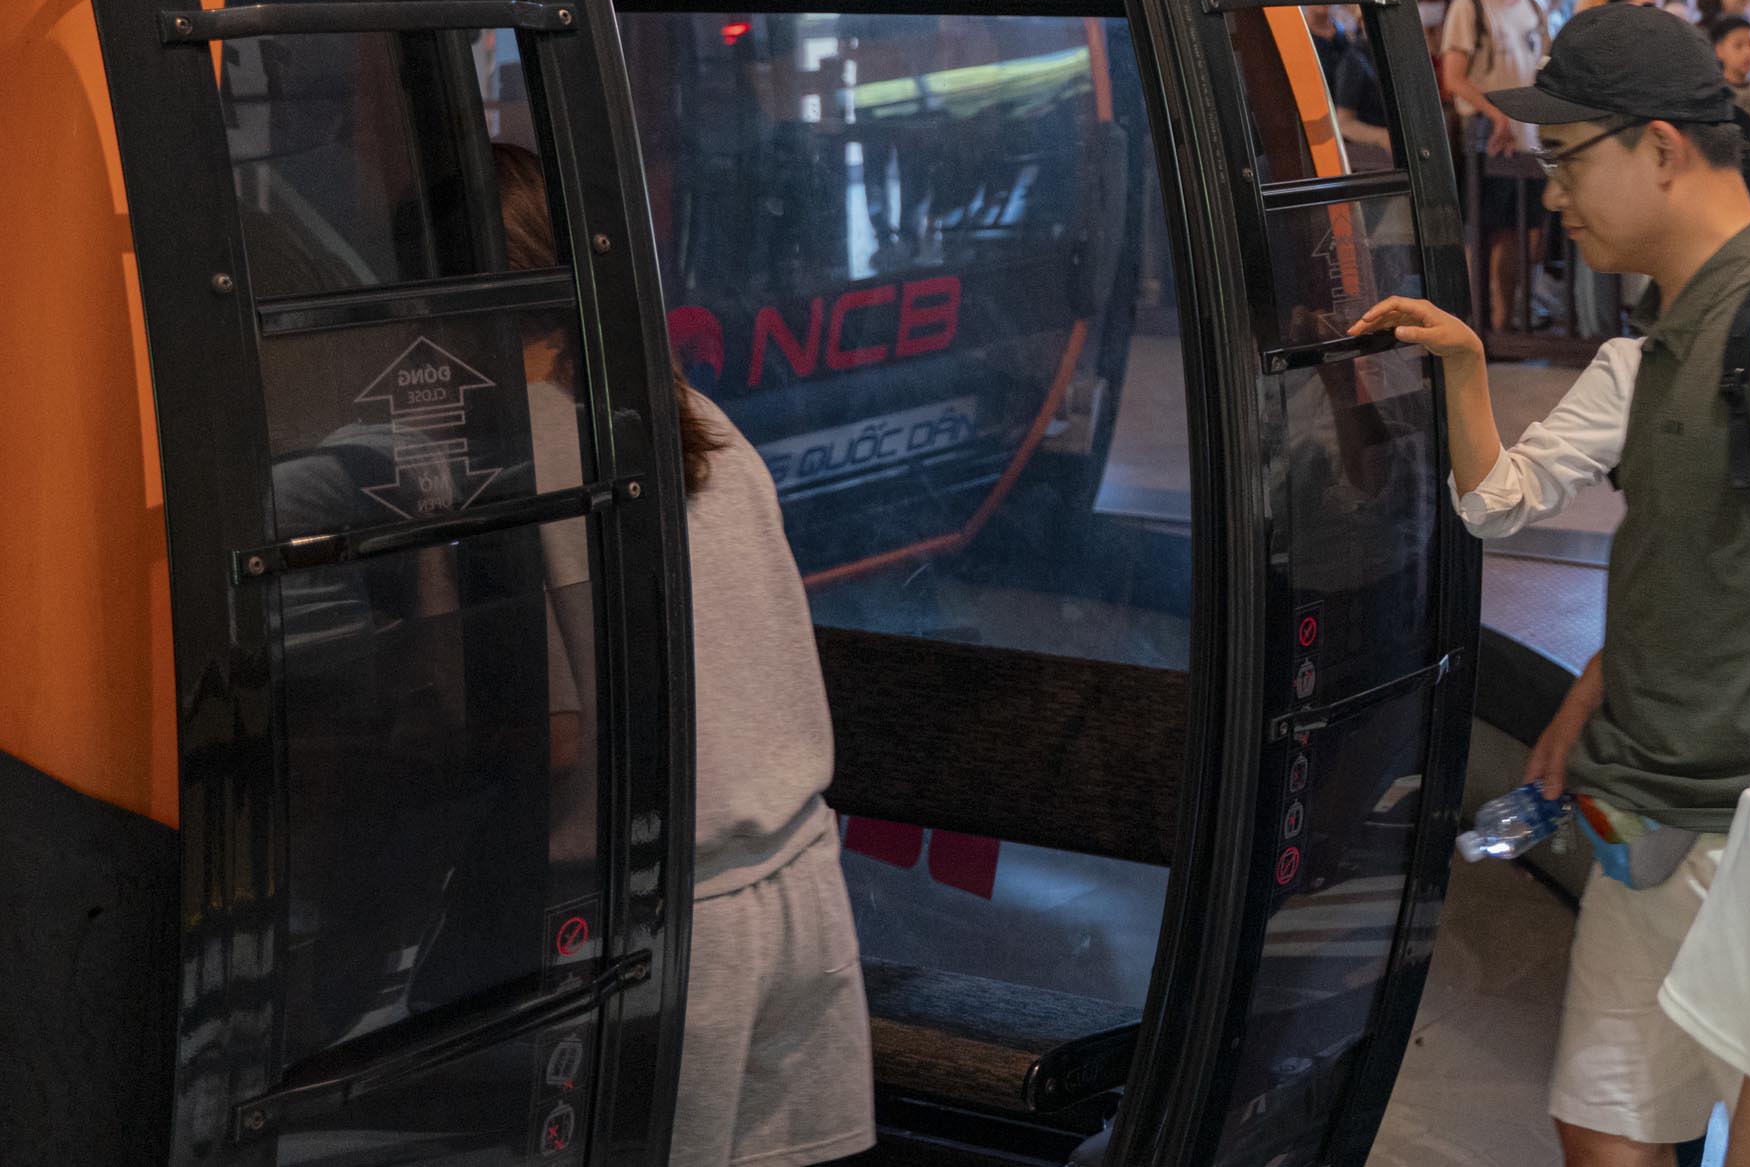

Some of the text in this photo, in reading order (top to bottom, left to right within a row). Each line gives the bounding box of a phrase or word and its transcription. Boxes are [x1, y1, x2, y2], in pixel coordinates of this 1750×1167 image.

[748, 275, 962, 386] NCB
[797, 420, 904, 477] QUỐC
[907, 405, 976, 452] DÂN
